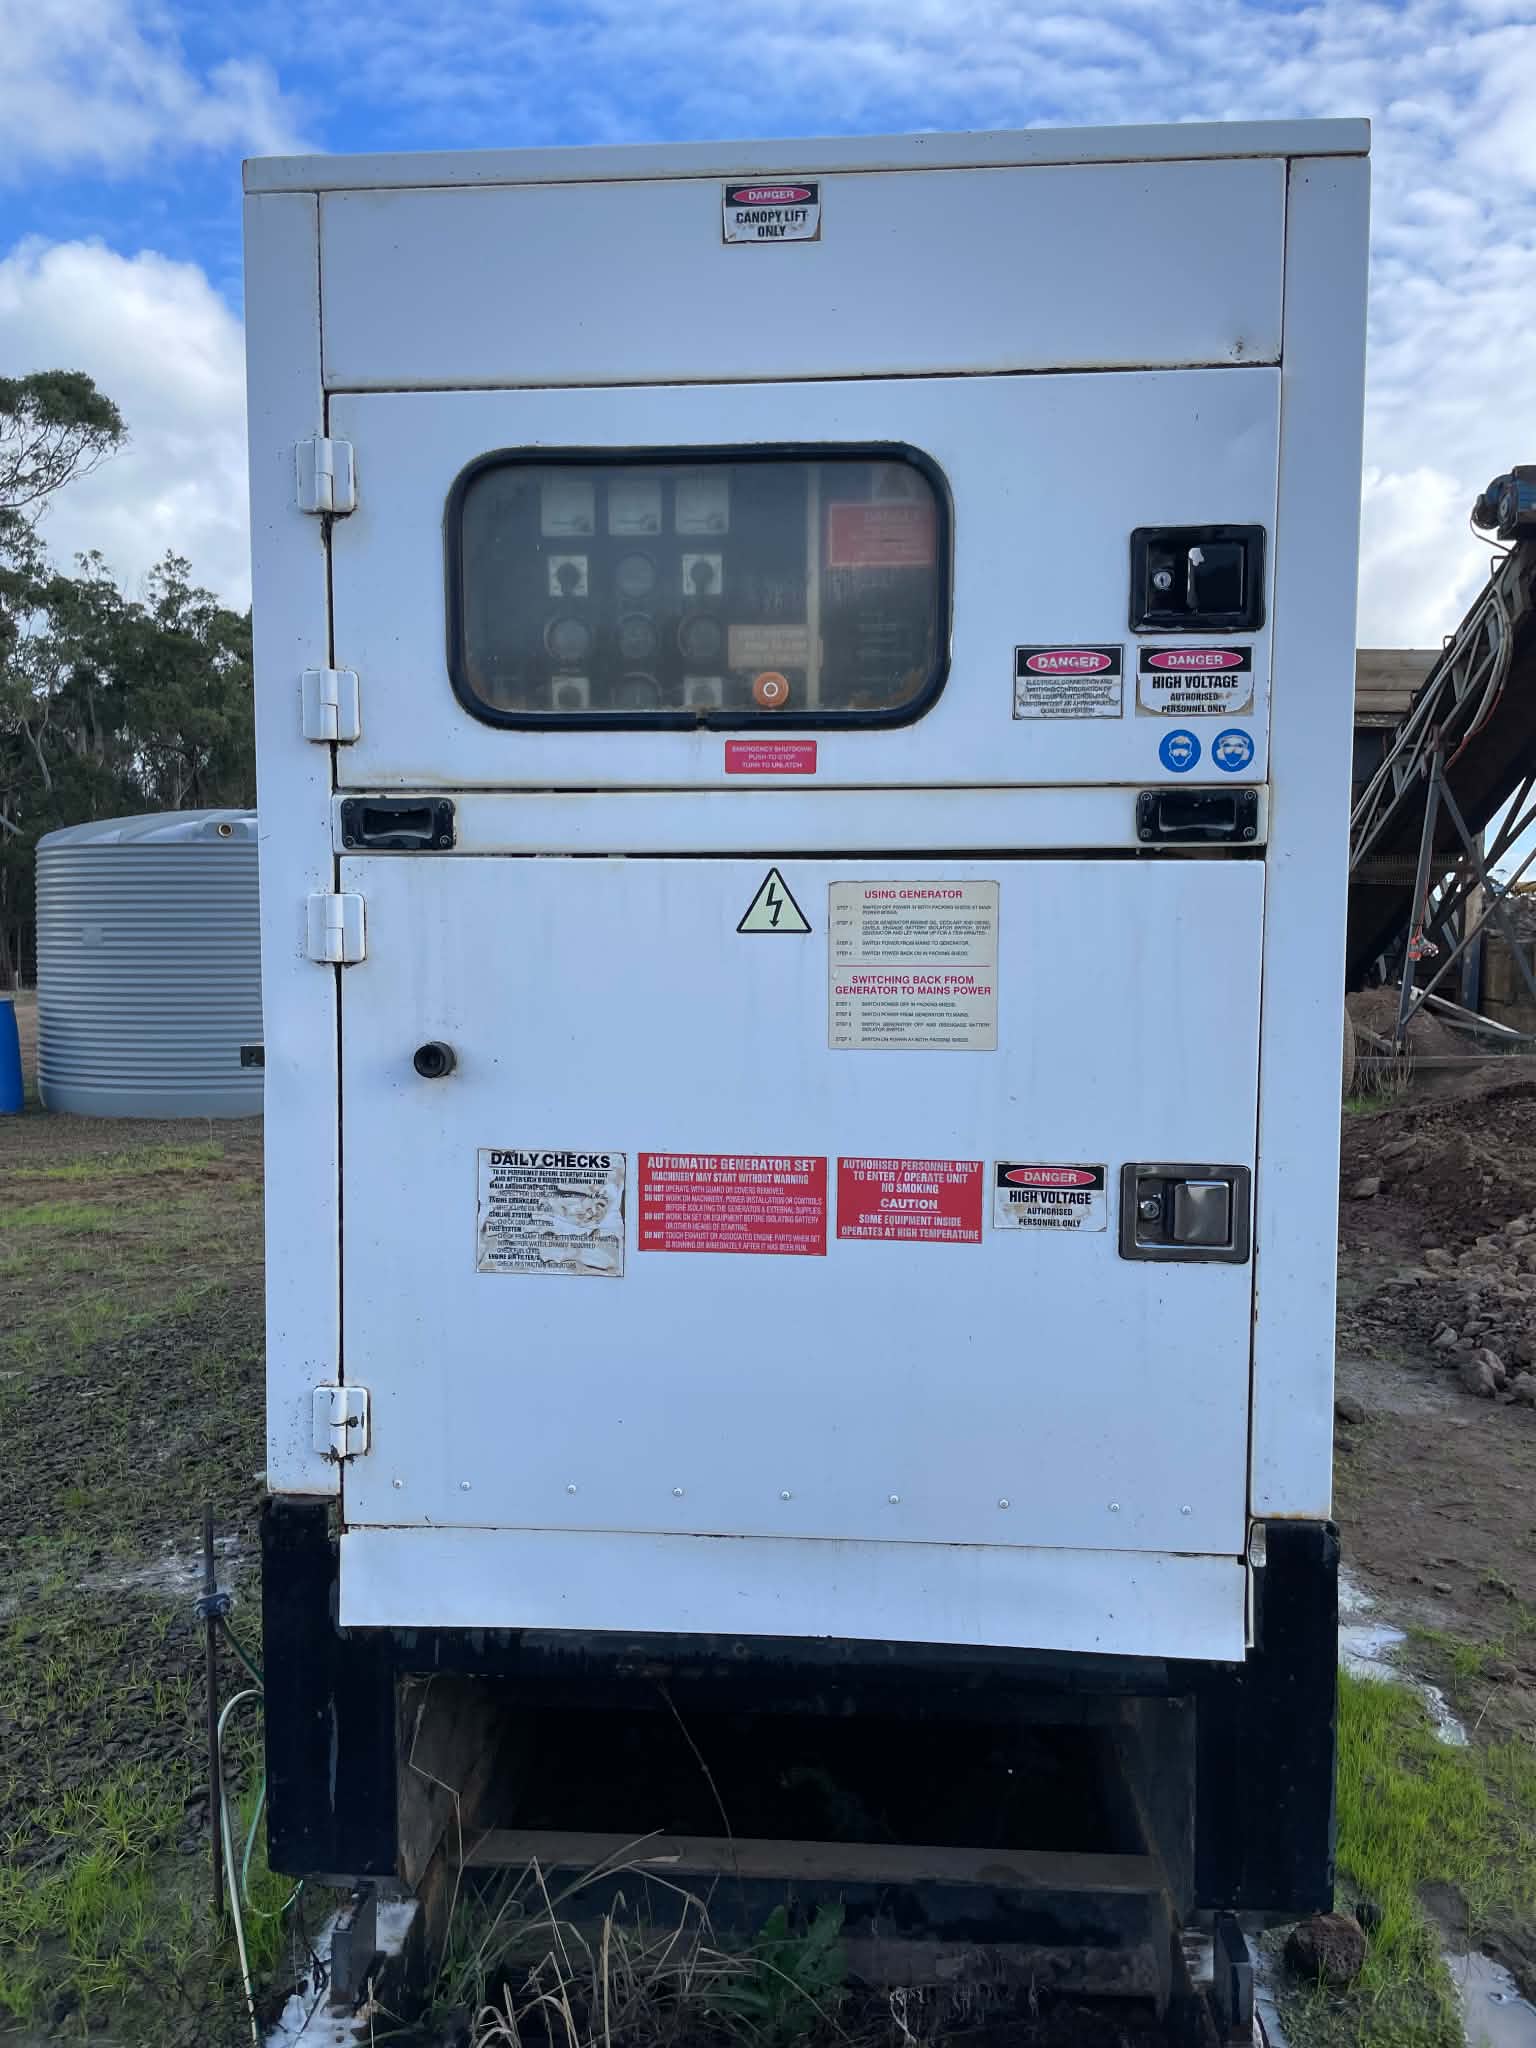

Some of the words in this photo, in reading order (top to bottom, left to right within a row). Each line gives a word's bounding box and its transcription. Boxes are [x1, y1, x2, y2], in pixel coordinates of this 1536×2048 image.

[748, 190, 794, 200] DANGER
[736, 211, 781, 223] CANOPY
[785, 210, 808, 222] LIFT
[758, 225, 786, 237] ONLY
[1037, 657, 1099, 668] DANGER
[1168, 655, 1223, 665] DANGER
[1152, 676, 1183, 688] HIGH
[1185, 675, 1238, 688] VOLTAGE
[1170, 693, 1218, 701] AUTHORISED
[1162, 705, 1205, 713] PERSONNEL
[1207, 704, 1227, 712] ONLY
[865, 890, 896, 899] USING
[899, 890, 963, 899] GENERATOR
[852, 976, 910, 984] SWITCHING
[913, 976, 941, 984] BACK
[945, 976, 974, 984] FROM
[836, 986, 898, 995] GENERATOR
[902, 986, 914, 995] TO
[918, 986, 950, 995] MAINS
[954, 986, 991, 995] POWER
[491, 1153, 539, 1166] DAILY
[542, 1154, 610, 1168] CHECKS
[648, 1156, 717, 1170] AUTOMATIC
[720, 1158, 791, 1171] GENERATOR
[794, 1159, 816, 1172] SET
[843, 1159, 898, 1171] AUTHORISED
[901, 1160, 953, 1172] PERSONNEL
[956, 1161, 979, 1173] ONLY
[651, 1171, 694, 1181] MACHINERY
[696, 1172, 711, 1182] MAY
[713, 1172, 737, 1182] START
[739, 1173, 772, 1183] WITHOUT
[774, 1174, 808, 1184] WARNING
[854, 1171, 864, 1181] TO
[866, 1171, 895, 1181] ENTER
[904, 1172, 944, 1182] OPERATE
[947, 1173, 967, 1183] UNIT
[1023, 1171, 1077, 1183] DANGER
[881, 1183, 894, 1193] NO
[896, 1183, 939, 1194] SMOKING
[880, 1198, 938, 1209] CAUTION
[1009, 1191, 1039, 1204] HIGH
[1041, 1191, 1091, 1205] VOLTAGE
[1027, 1207, 1072, 1216] AUTHORISED
[859, 1213, 883, 1224] SOME
[884, 1214, 932, 1225] EQUIPMENT
[934, 1215, 961, 1226] INSIDE
[1019, 1219, 1061, 1227] PERSONNEL
[1062, 1219, 1081, 1228] ONLY
[841, 1226, 883, 1237] OPERATES
[884, 1227, 896, 1237] AT
[897, 1227, 918, 1238] HIGH
[920, 1228, 979, 1239] TEMPERATURE
